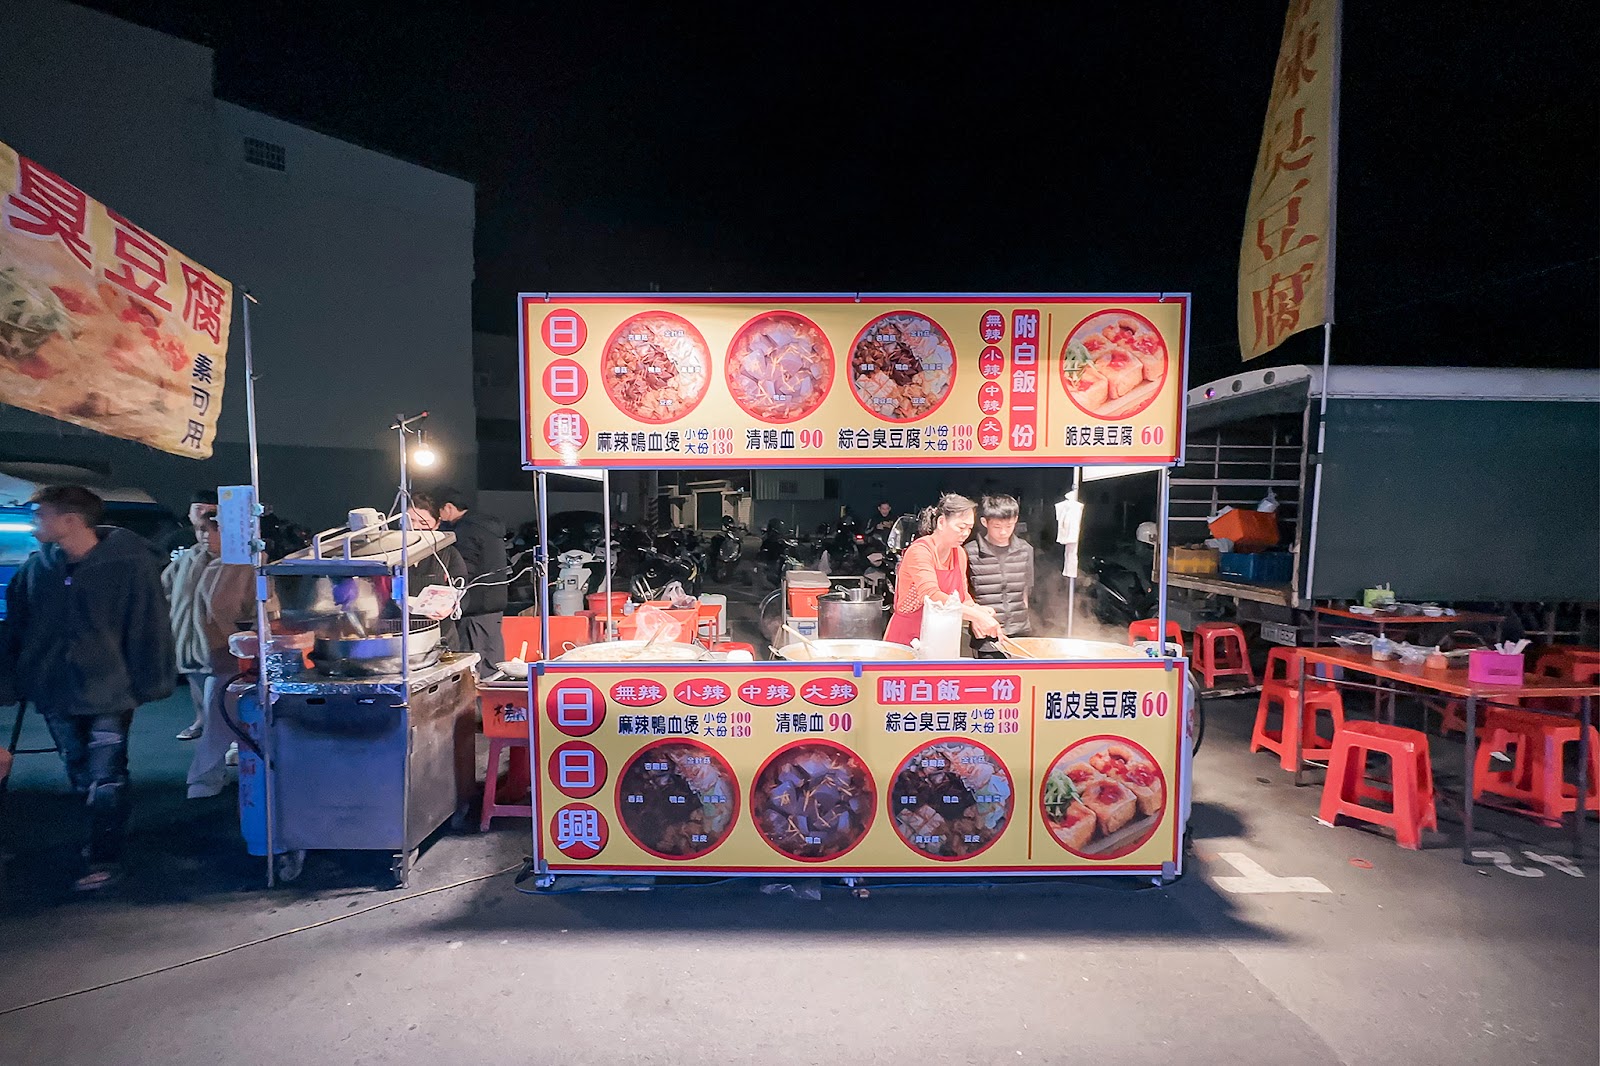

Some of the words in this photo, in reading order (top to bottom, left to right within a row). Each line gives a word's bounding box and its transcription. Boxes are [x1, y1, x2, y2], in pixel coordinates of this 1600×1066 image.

[9, 153, 226, 345] 臭豆腐
[984, 314, 1002, 340] 無辣
[983, 352, 1002, 376] 小辣
[548, 316, 582, 447] 日日興
[1011, 314, 1037, 447] 附白飯一份
[181, 353, 212, 450] 素可用
[982, 386, 999, 412] 中辣
[684, 428, 709, 441] 小份
[711, 427, 734, 441] 100
[746, 429, 796, 450] 清鴨血
[800, 429, 823, 449] 90
[838, 428, 921, 449] 綜合臭豆腐
[924, 425, 949, 438] 小份
[951, 424, 973, 438] 100
[982, 421, 999, 447] 大辣
[1065, 426, 1133, 446] 脆皮臭豆腐
[1141, 426, 1164, 445] 60
[597, 431, 681, 453] 麻辣鴨血煲
[684, 442, 709, 455] 大份
[711, 442, 734, 455] 130
[924, 439, 949, 451] 大份
[951, 439, 973, 451] 130
[614, 686, 661, 701] 無辣
[678, 685, 727, 700] 小辣
[741, 685, 792, 700] 中辣
[805, 684, 855, 700] 大辣
[882, 678, 1015, 702] 附白飯一份
[970, 708, 994, 720] 小份
[997, 708, 1019, 720] 100
[1045, 691, 1137, 720] 脆皮臭豆腐
[1141, 691, 1168, 717] 60
[618, 714, 699, 735] 麻辣鴨血煲
[703, 712, 727, 724] 小份
[730, 712, 751, 725] 100
[776, 713, 824, 733] 清鴨血
[829, 713, 852, 732] 90
[885, 711, 967, 732] 綜合臭豆腐
[970, 722, 994, 734] 大份
[997, 722, 1019, 734] 130
[703, 726, 727, 738] 大份
[730, 725, 751, 737] 130
[557, 687, 600, 850] 日日興
